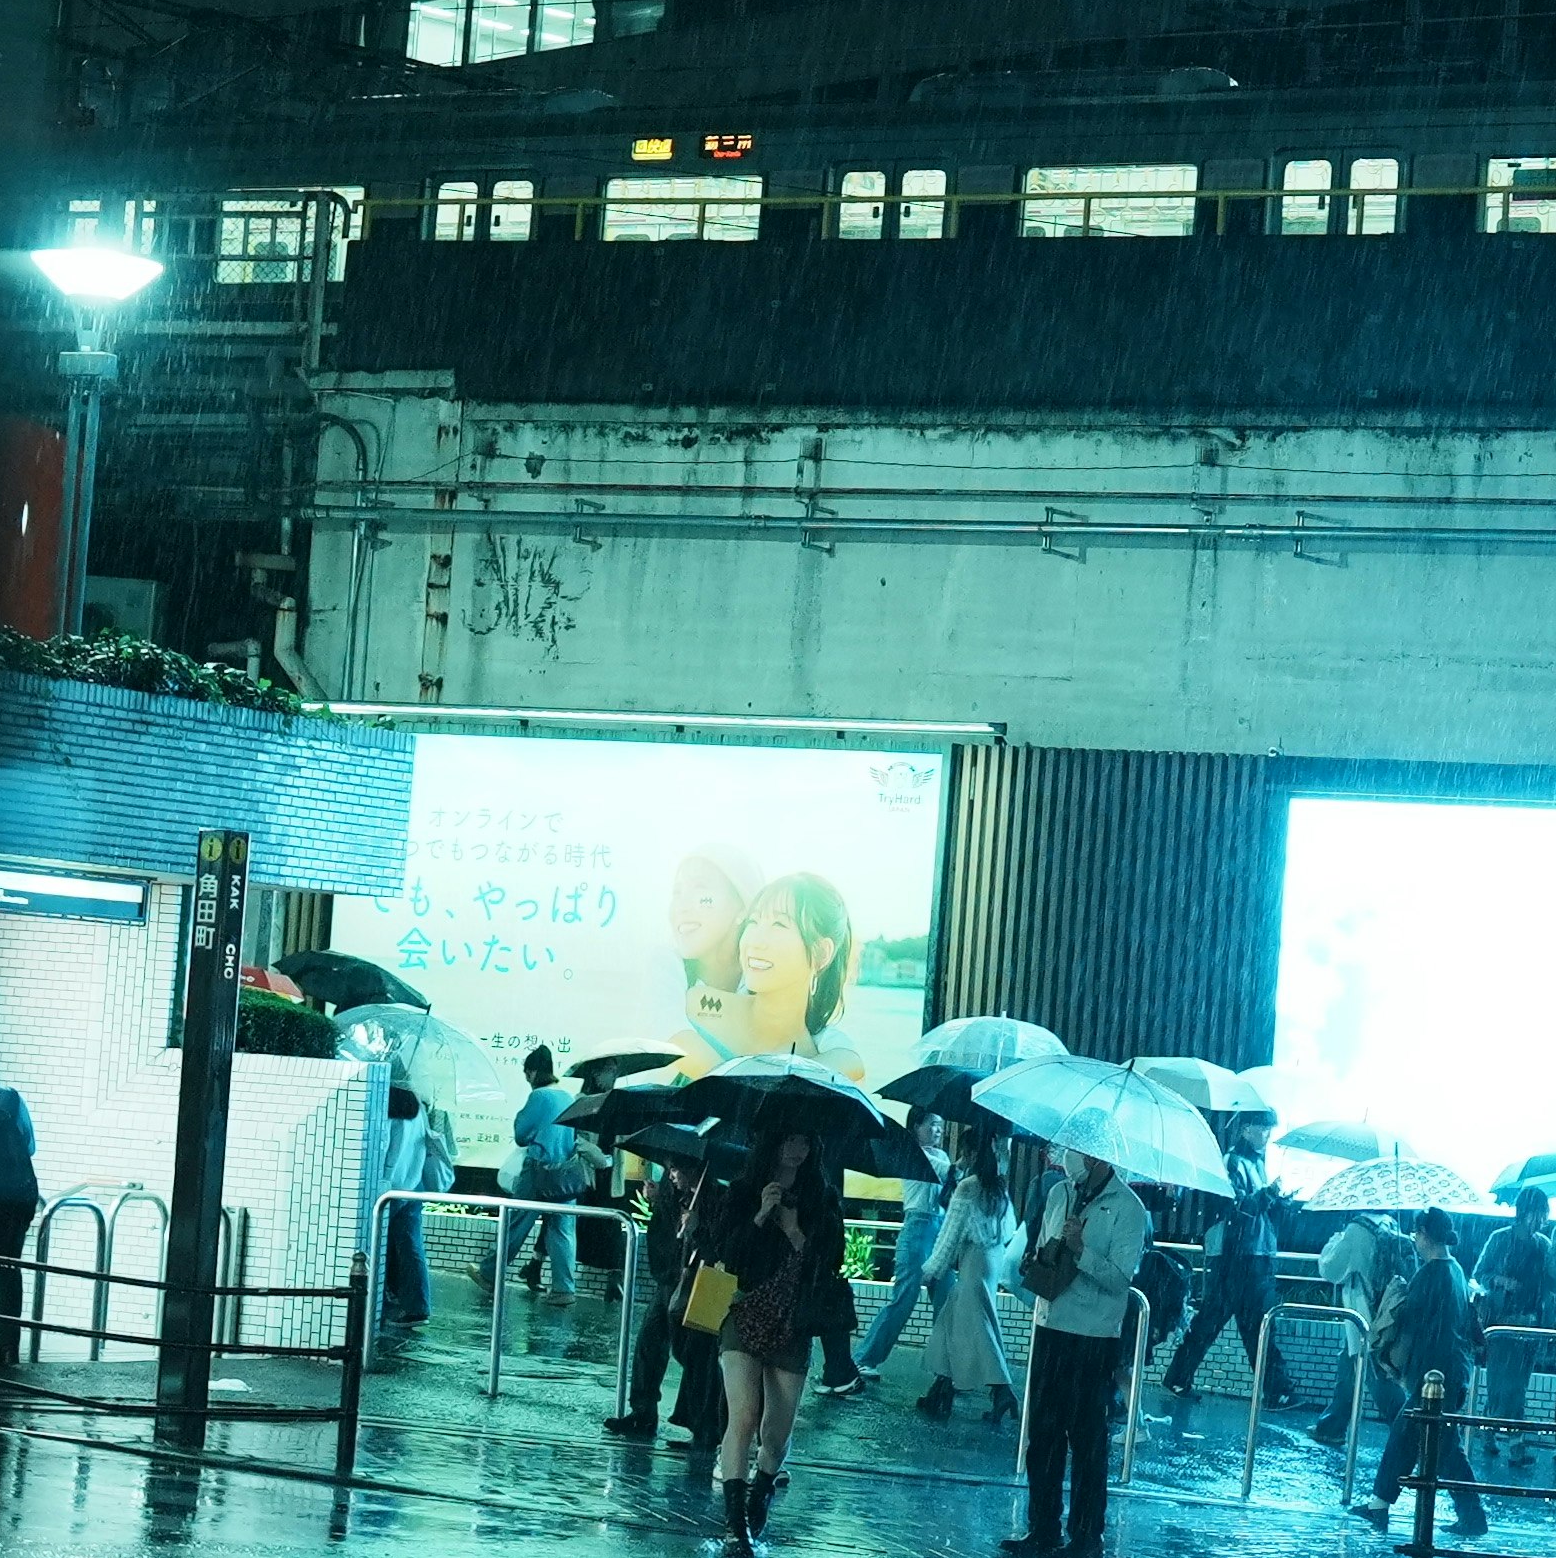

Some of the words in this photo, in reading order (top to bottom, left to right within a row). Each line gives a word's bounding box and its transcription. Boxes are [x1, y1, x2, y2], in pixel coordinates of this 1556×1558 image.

[428, 808, 564, 833] オンラインで
[194, 873, 218, 950] 角田町
[224, 943, 237, 980] CHO
[396, 927, 573, 980] 会いたい。
